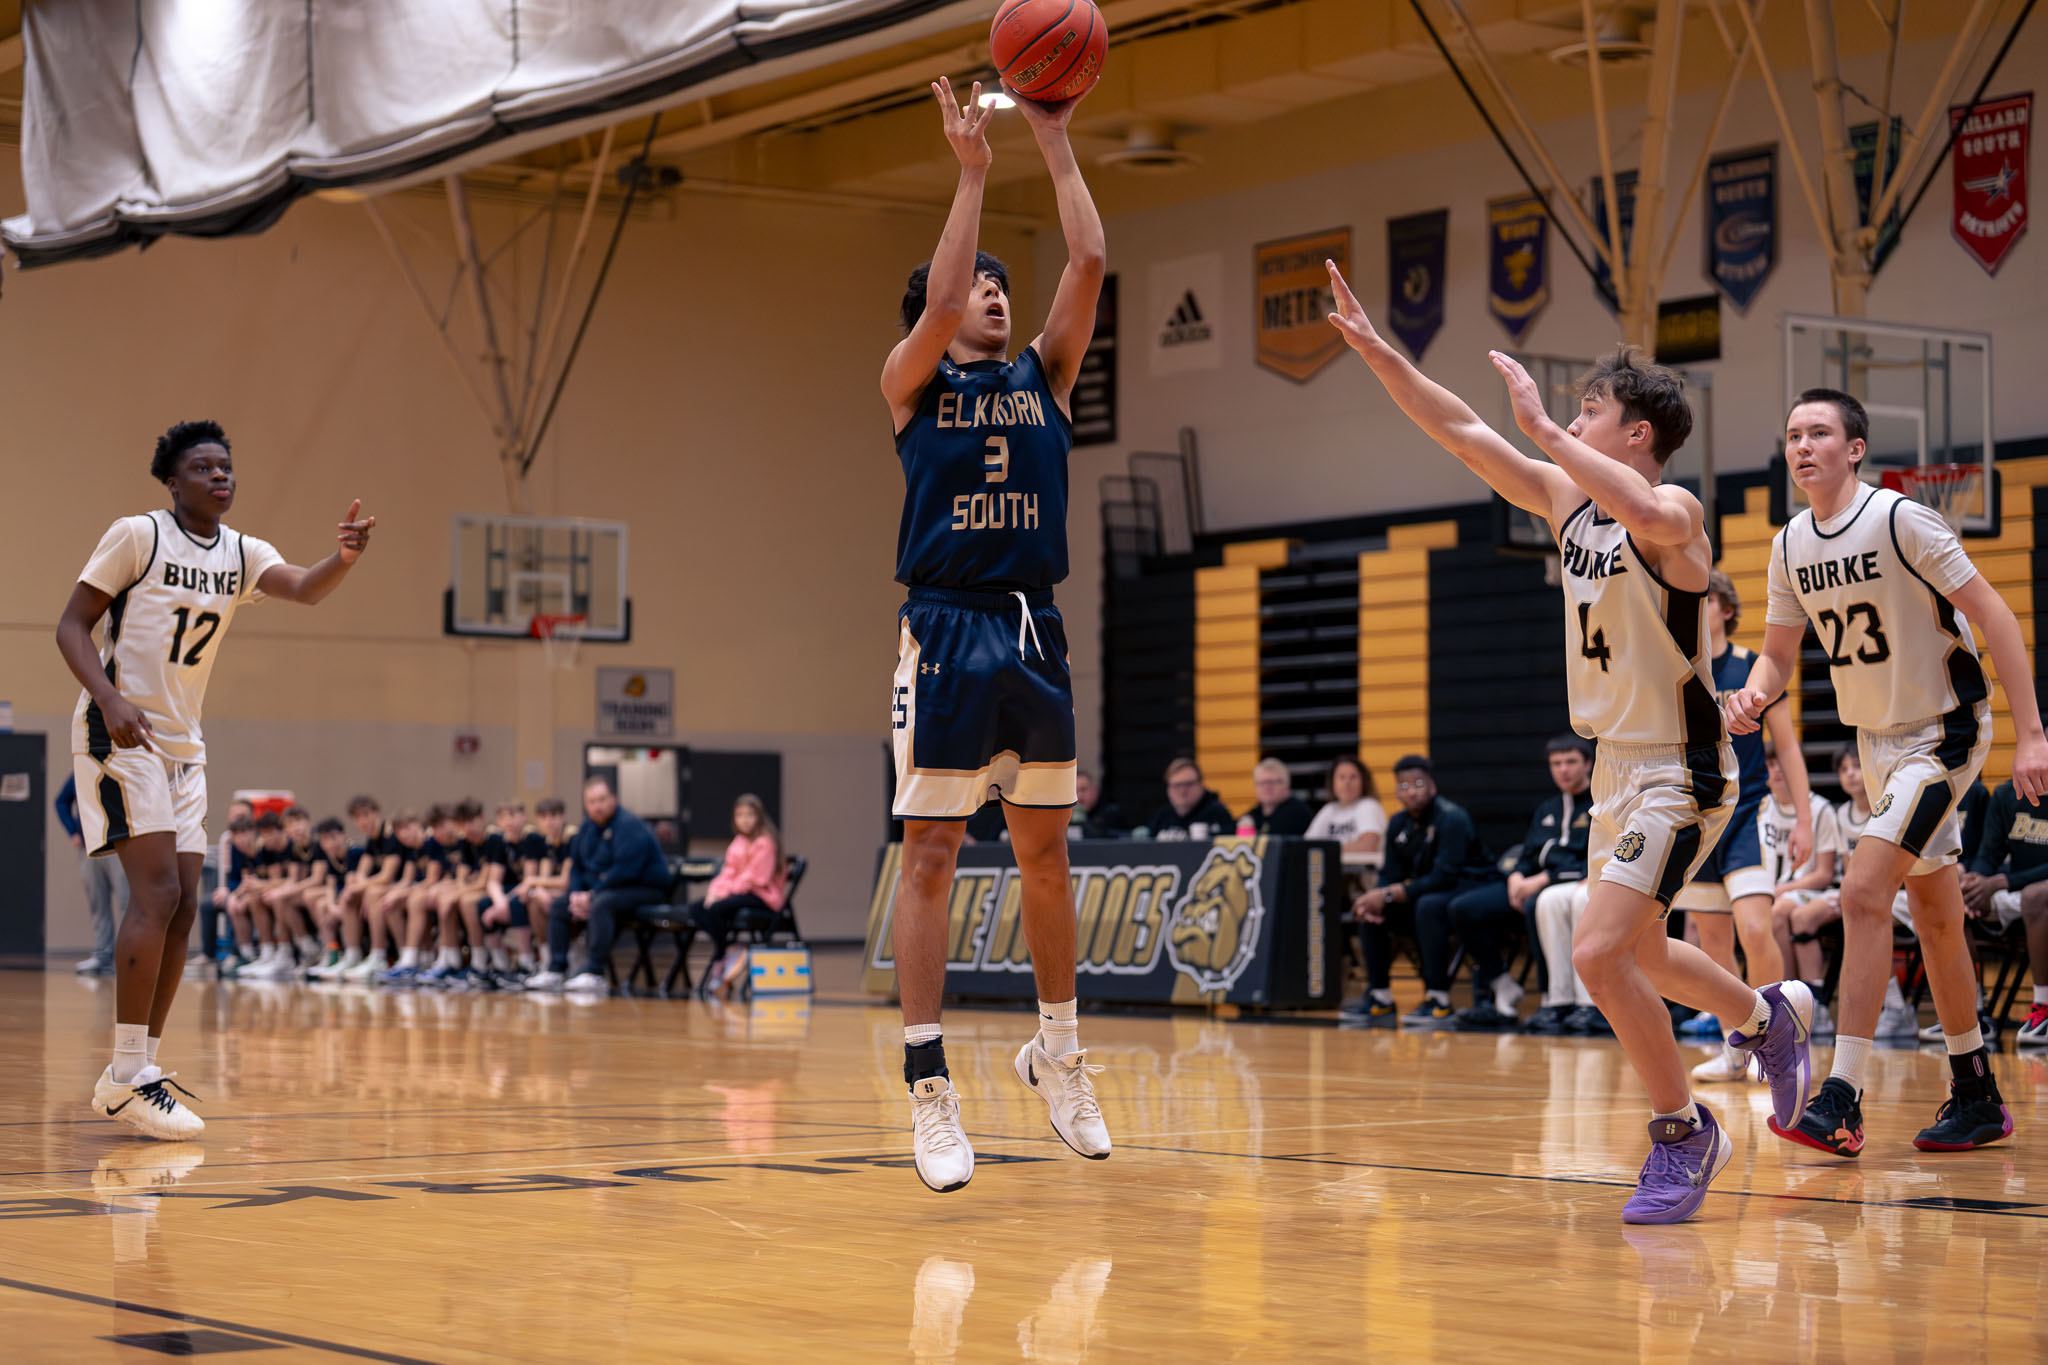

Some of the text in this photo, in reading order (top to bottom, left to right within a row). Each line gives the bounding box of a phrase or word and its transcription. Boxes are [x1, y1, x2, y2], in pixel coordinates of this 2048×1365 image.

[984, 435, 1010, 483] 3
[951, 492, 1039, 531] SOUTH
[163, 562, 238, 596] BURKE
[1795, 550, 1883, 595] BURKE
[168, 606, 221, 666] 12
[1578, 602, 1611, 673] 4
[1817, 602, 1891, 667] 23
